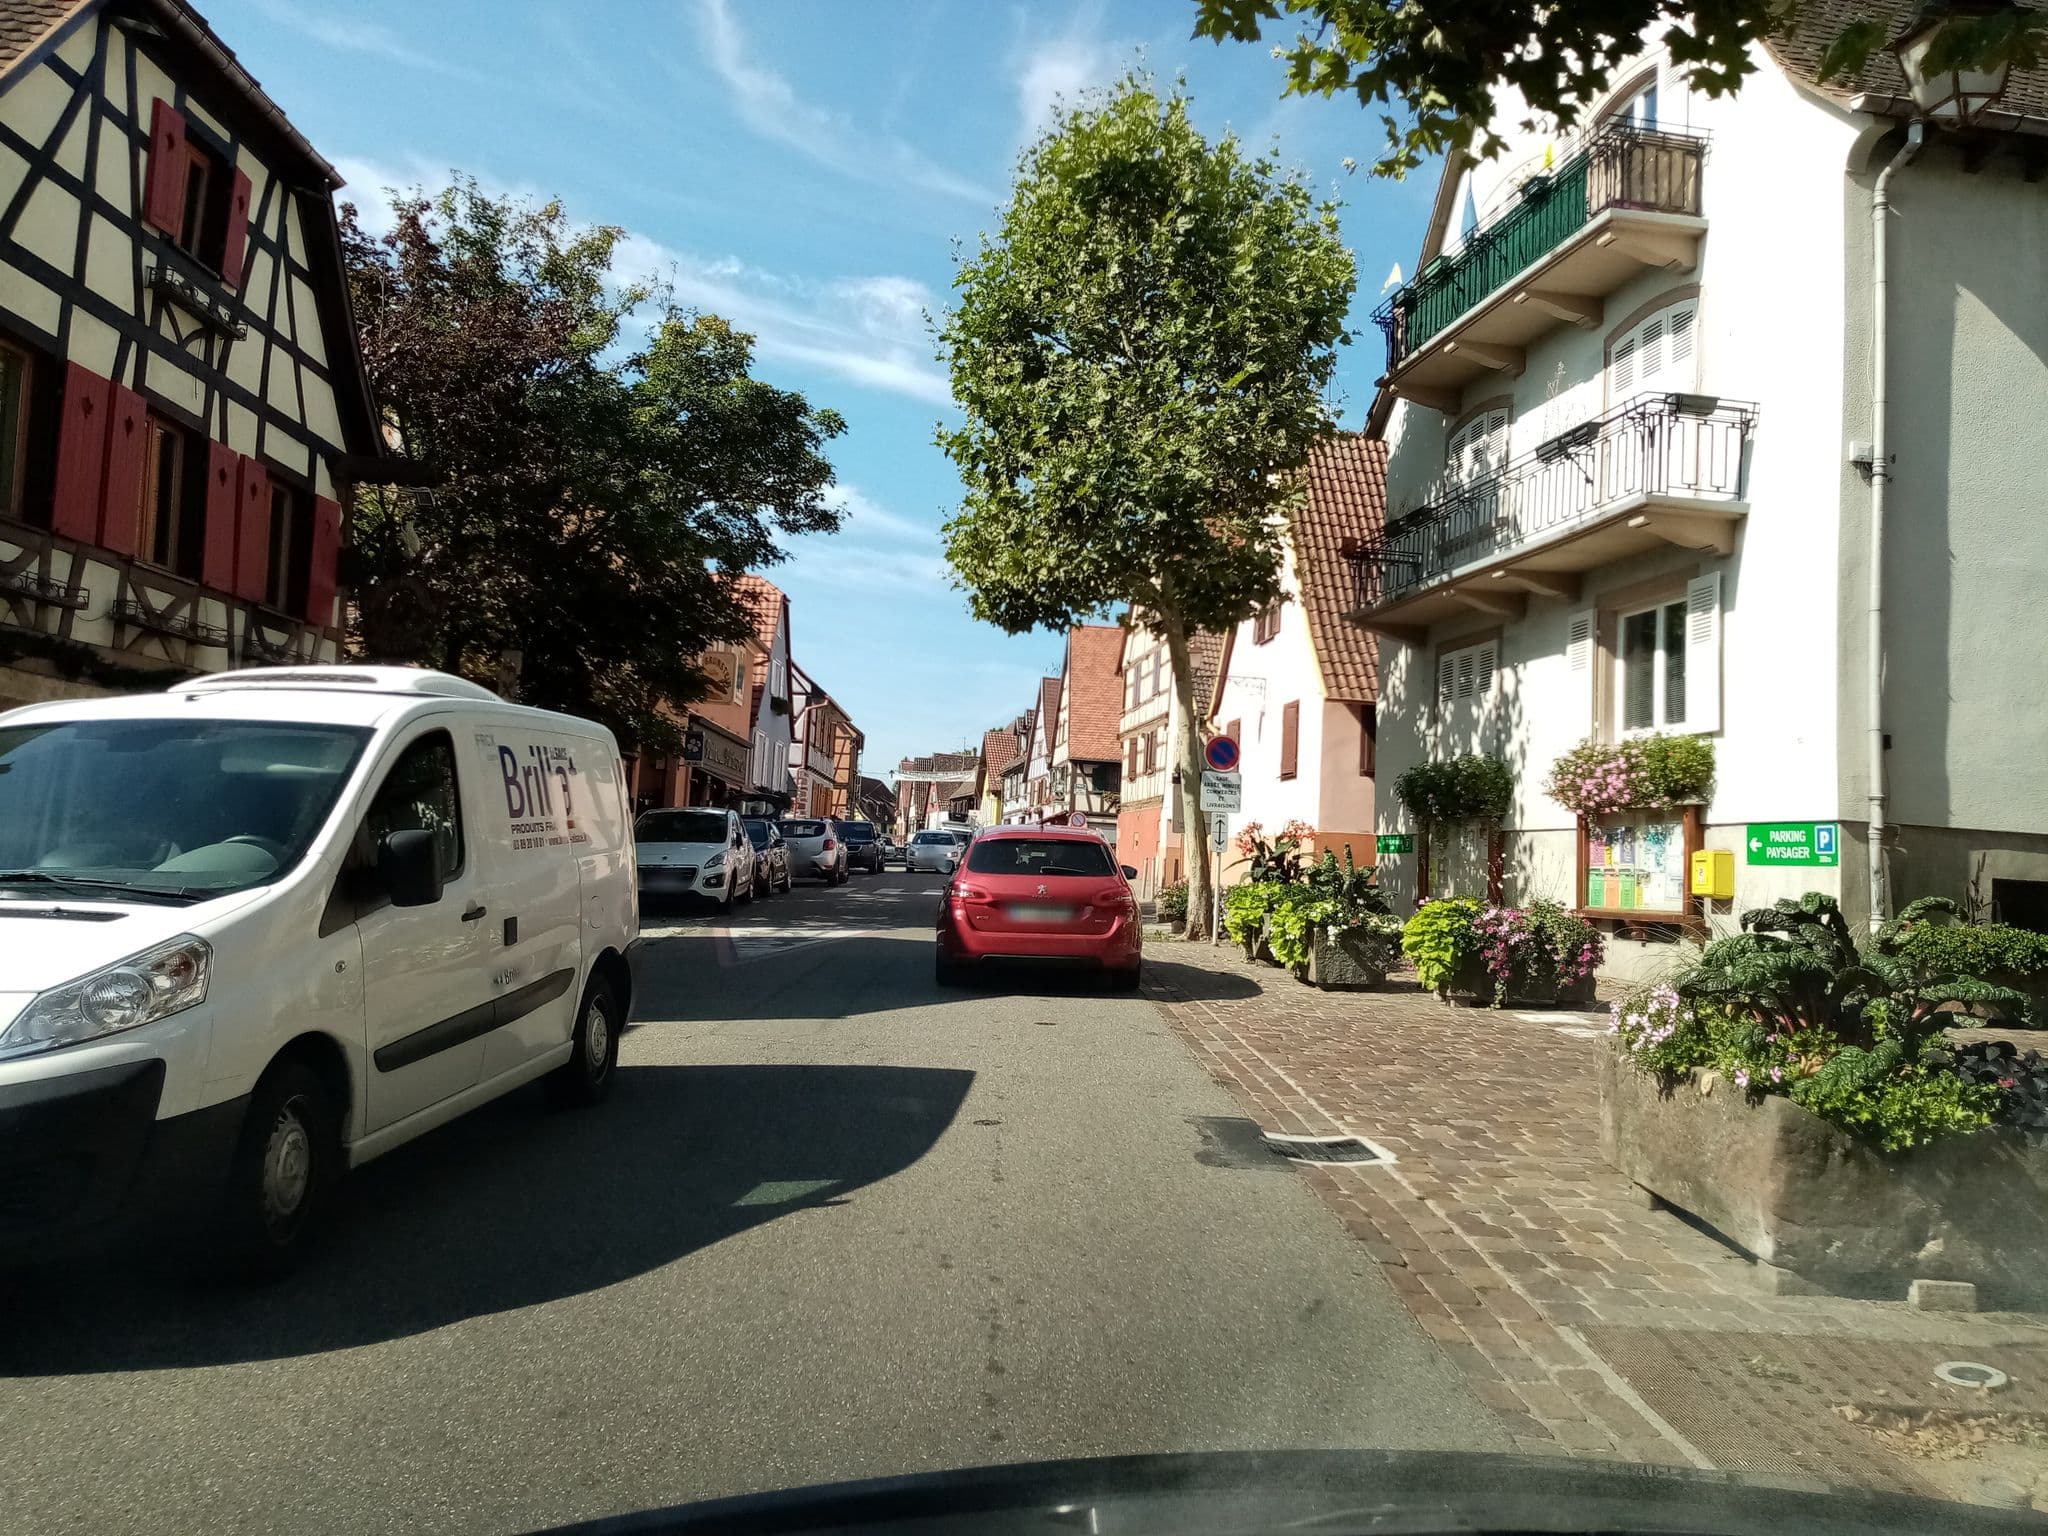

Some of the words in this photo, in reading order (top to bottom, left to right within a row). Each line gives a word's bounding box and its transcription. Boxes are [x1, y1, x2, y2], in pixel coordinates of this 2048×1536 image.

[511, 822, 545, 834] PRODUITS
[1769, 831, 1806, 842] PARKING
[1819, 831, 1830, 848] P
[1766, 847, 1810, 858] PAYSAGER
